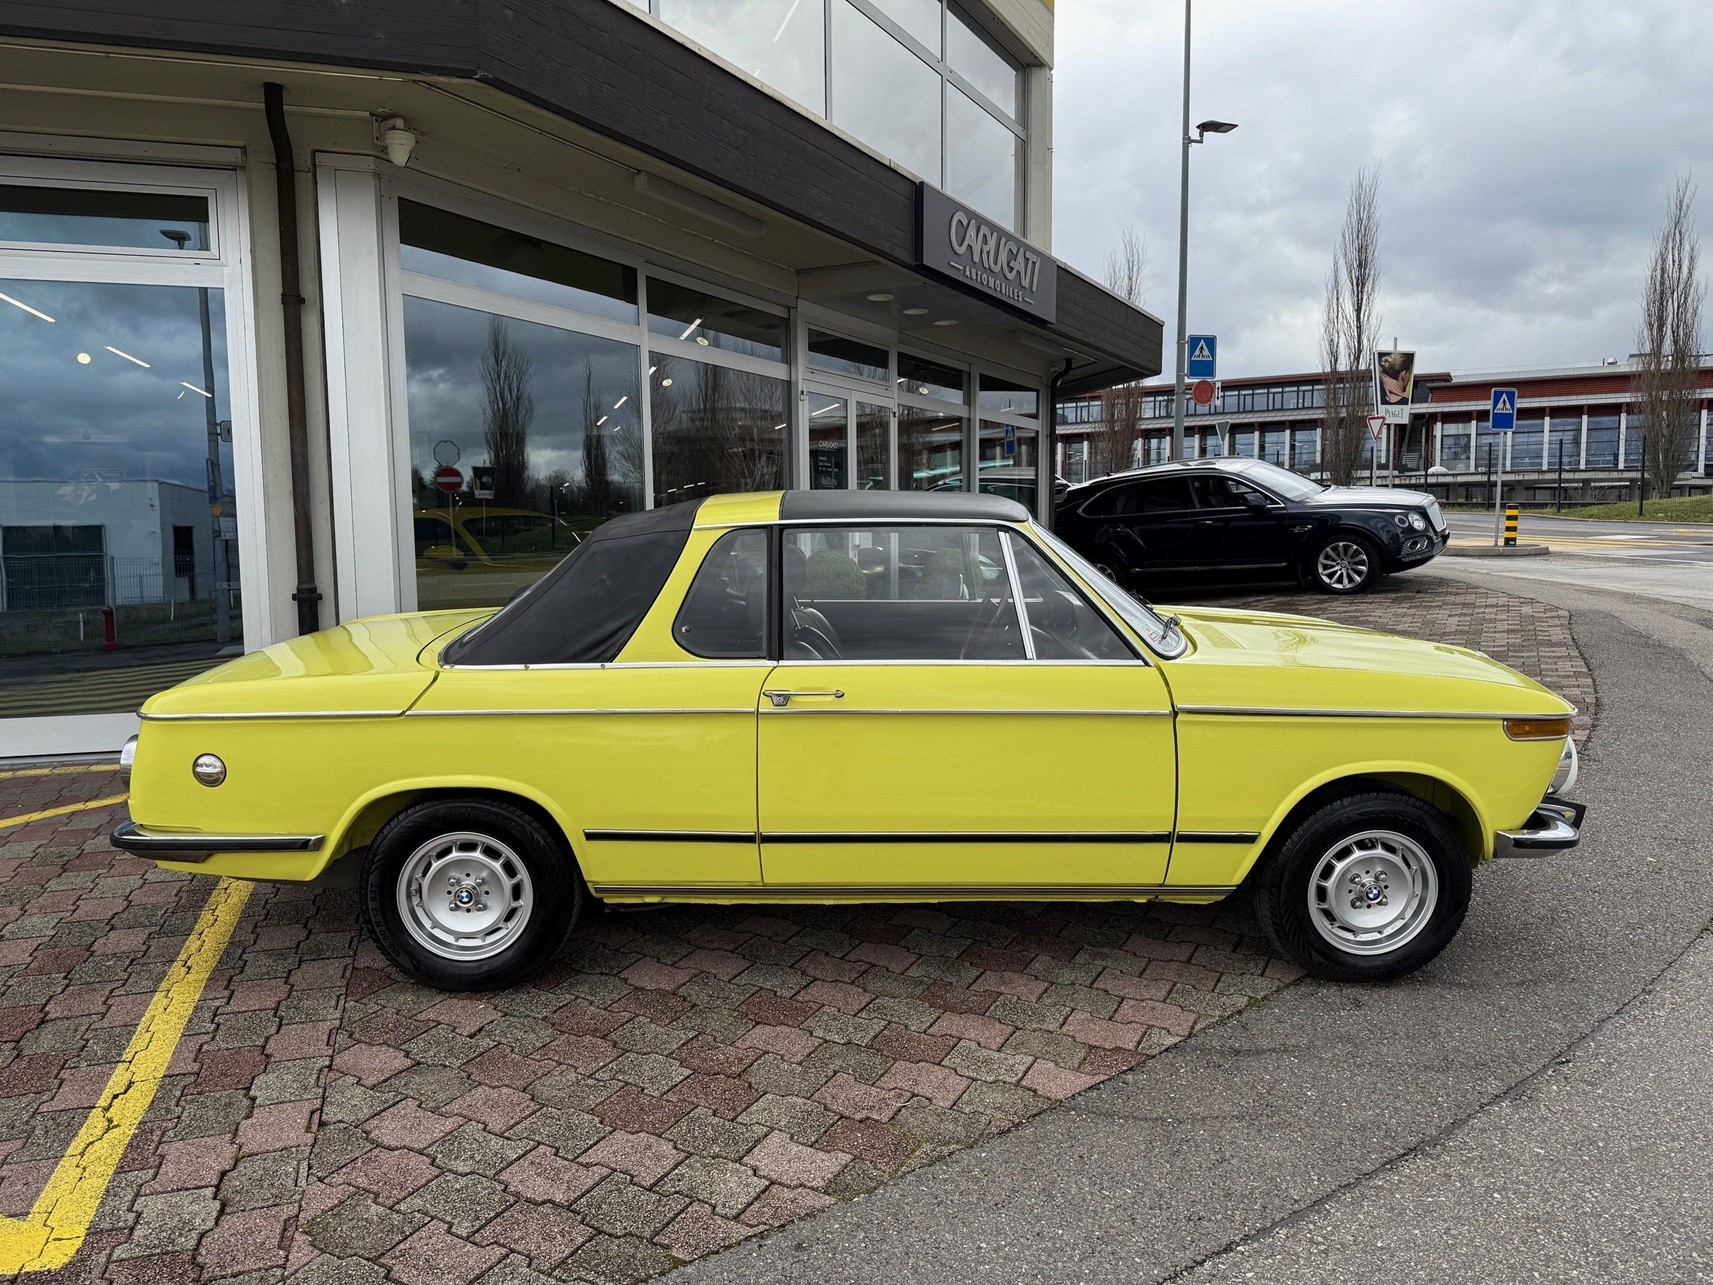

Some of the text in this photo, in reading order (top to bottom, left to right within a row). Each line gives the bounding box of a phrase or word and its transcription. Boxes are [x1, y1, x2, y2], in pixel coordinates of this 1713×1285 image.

[950, 211, 1041, 292] CARUGATI
[964, 265, 1023, 302] AUTOMOBILES
[1384, 408, 1404, 419] PIAGET
[371, 907, 379, 917] 13
[375, 919, 383, 928] R
[379, 930, 402, 958] 165/80
